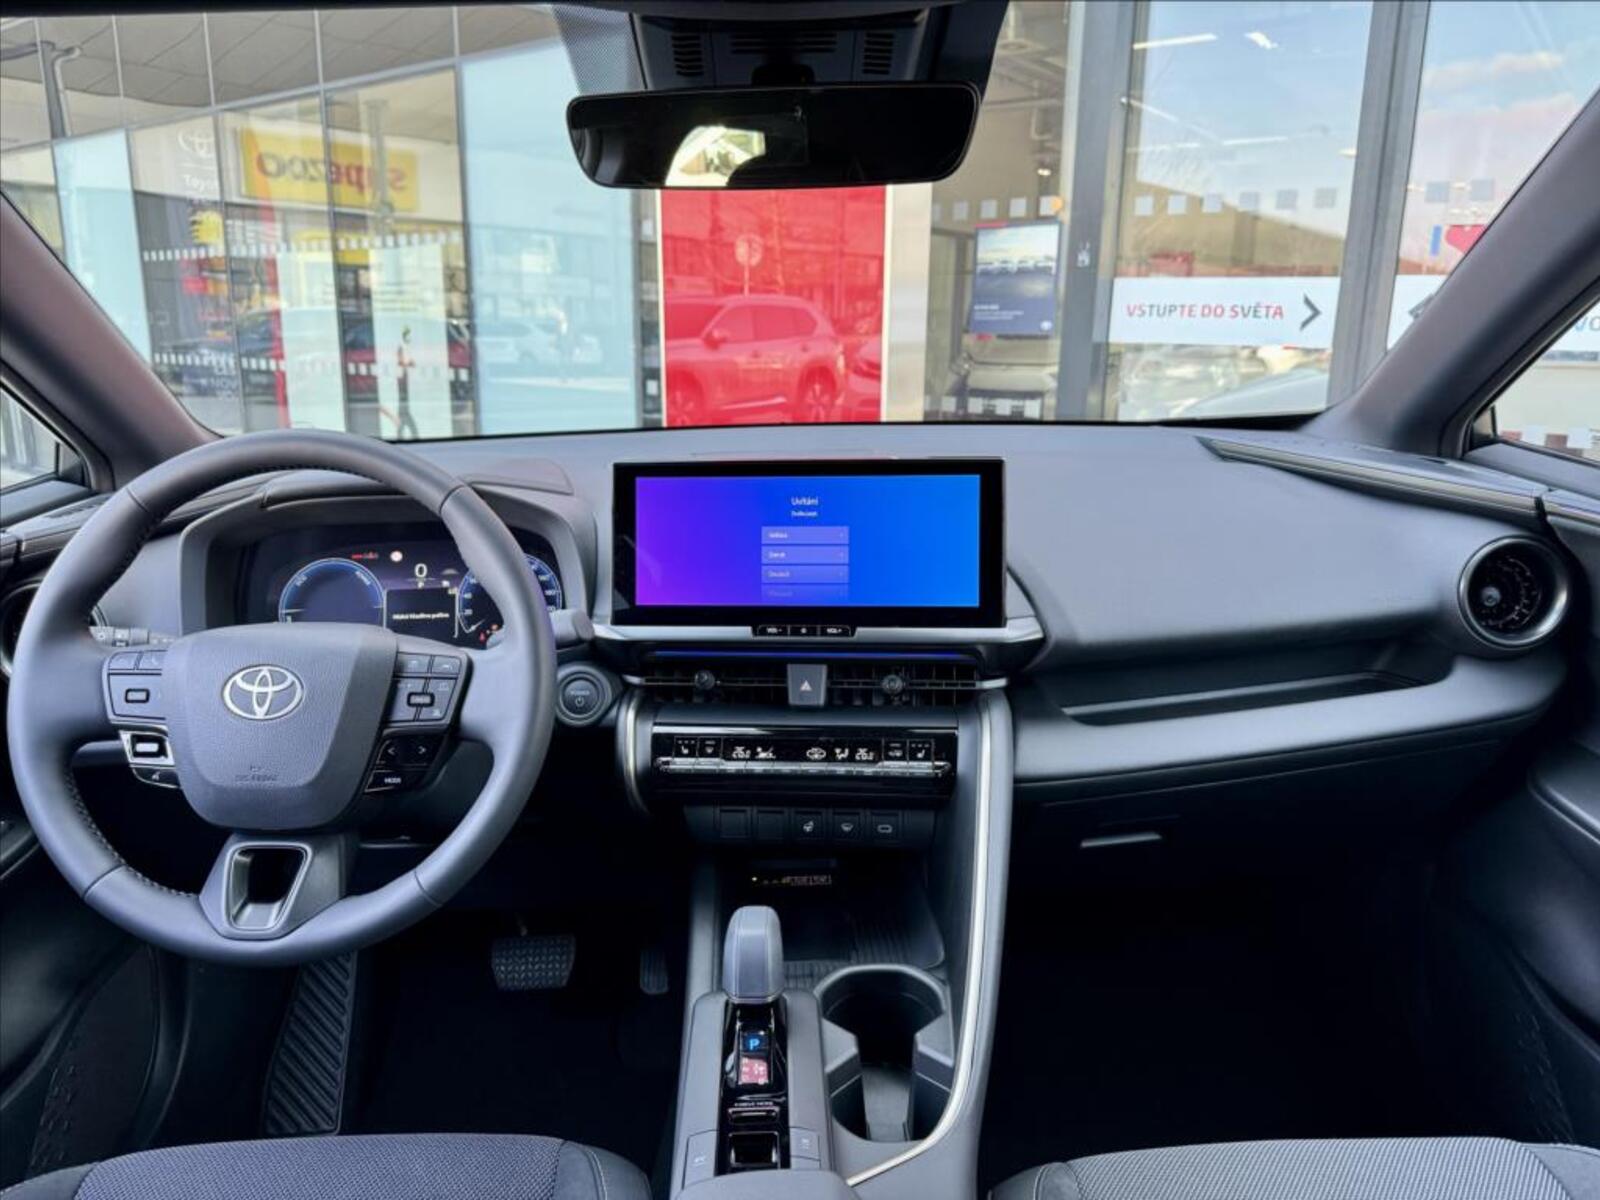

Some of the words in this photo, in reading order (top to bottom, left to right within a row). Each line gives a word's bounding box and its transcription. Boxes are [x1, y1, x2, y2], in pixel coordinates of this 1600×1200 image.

[1126, 303, 1197, 318] VSTUPTE
[1200, 304, 1225, 318] DO
[1229, 301, 1285, 320] SVĚTA
[414, 563, 428, 578] 0
[750, 1038, 760, 1050] P
